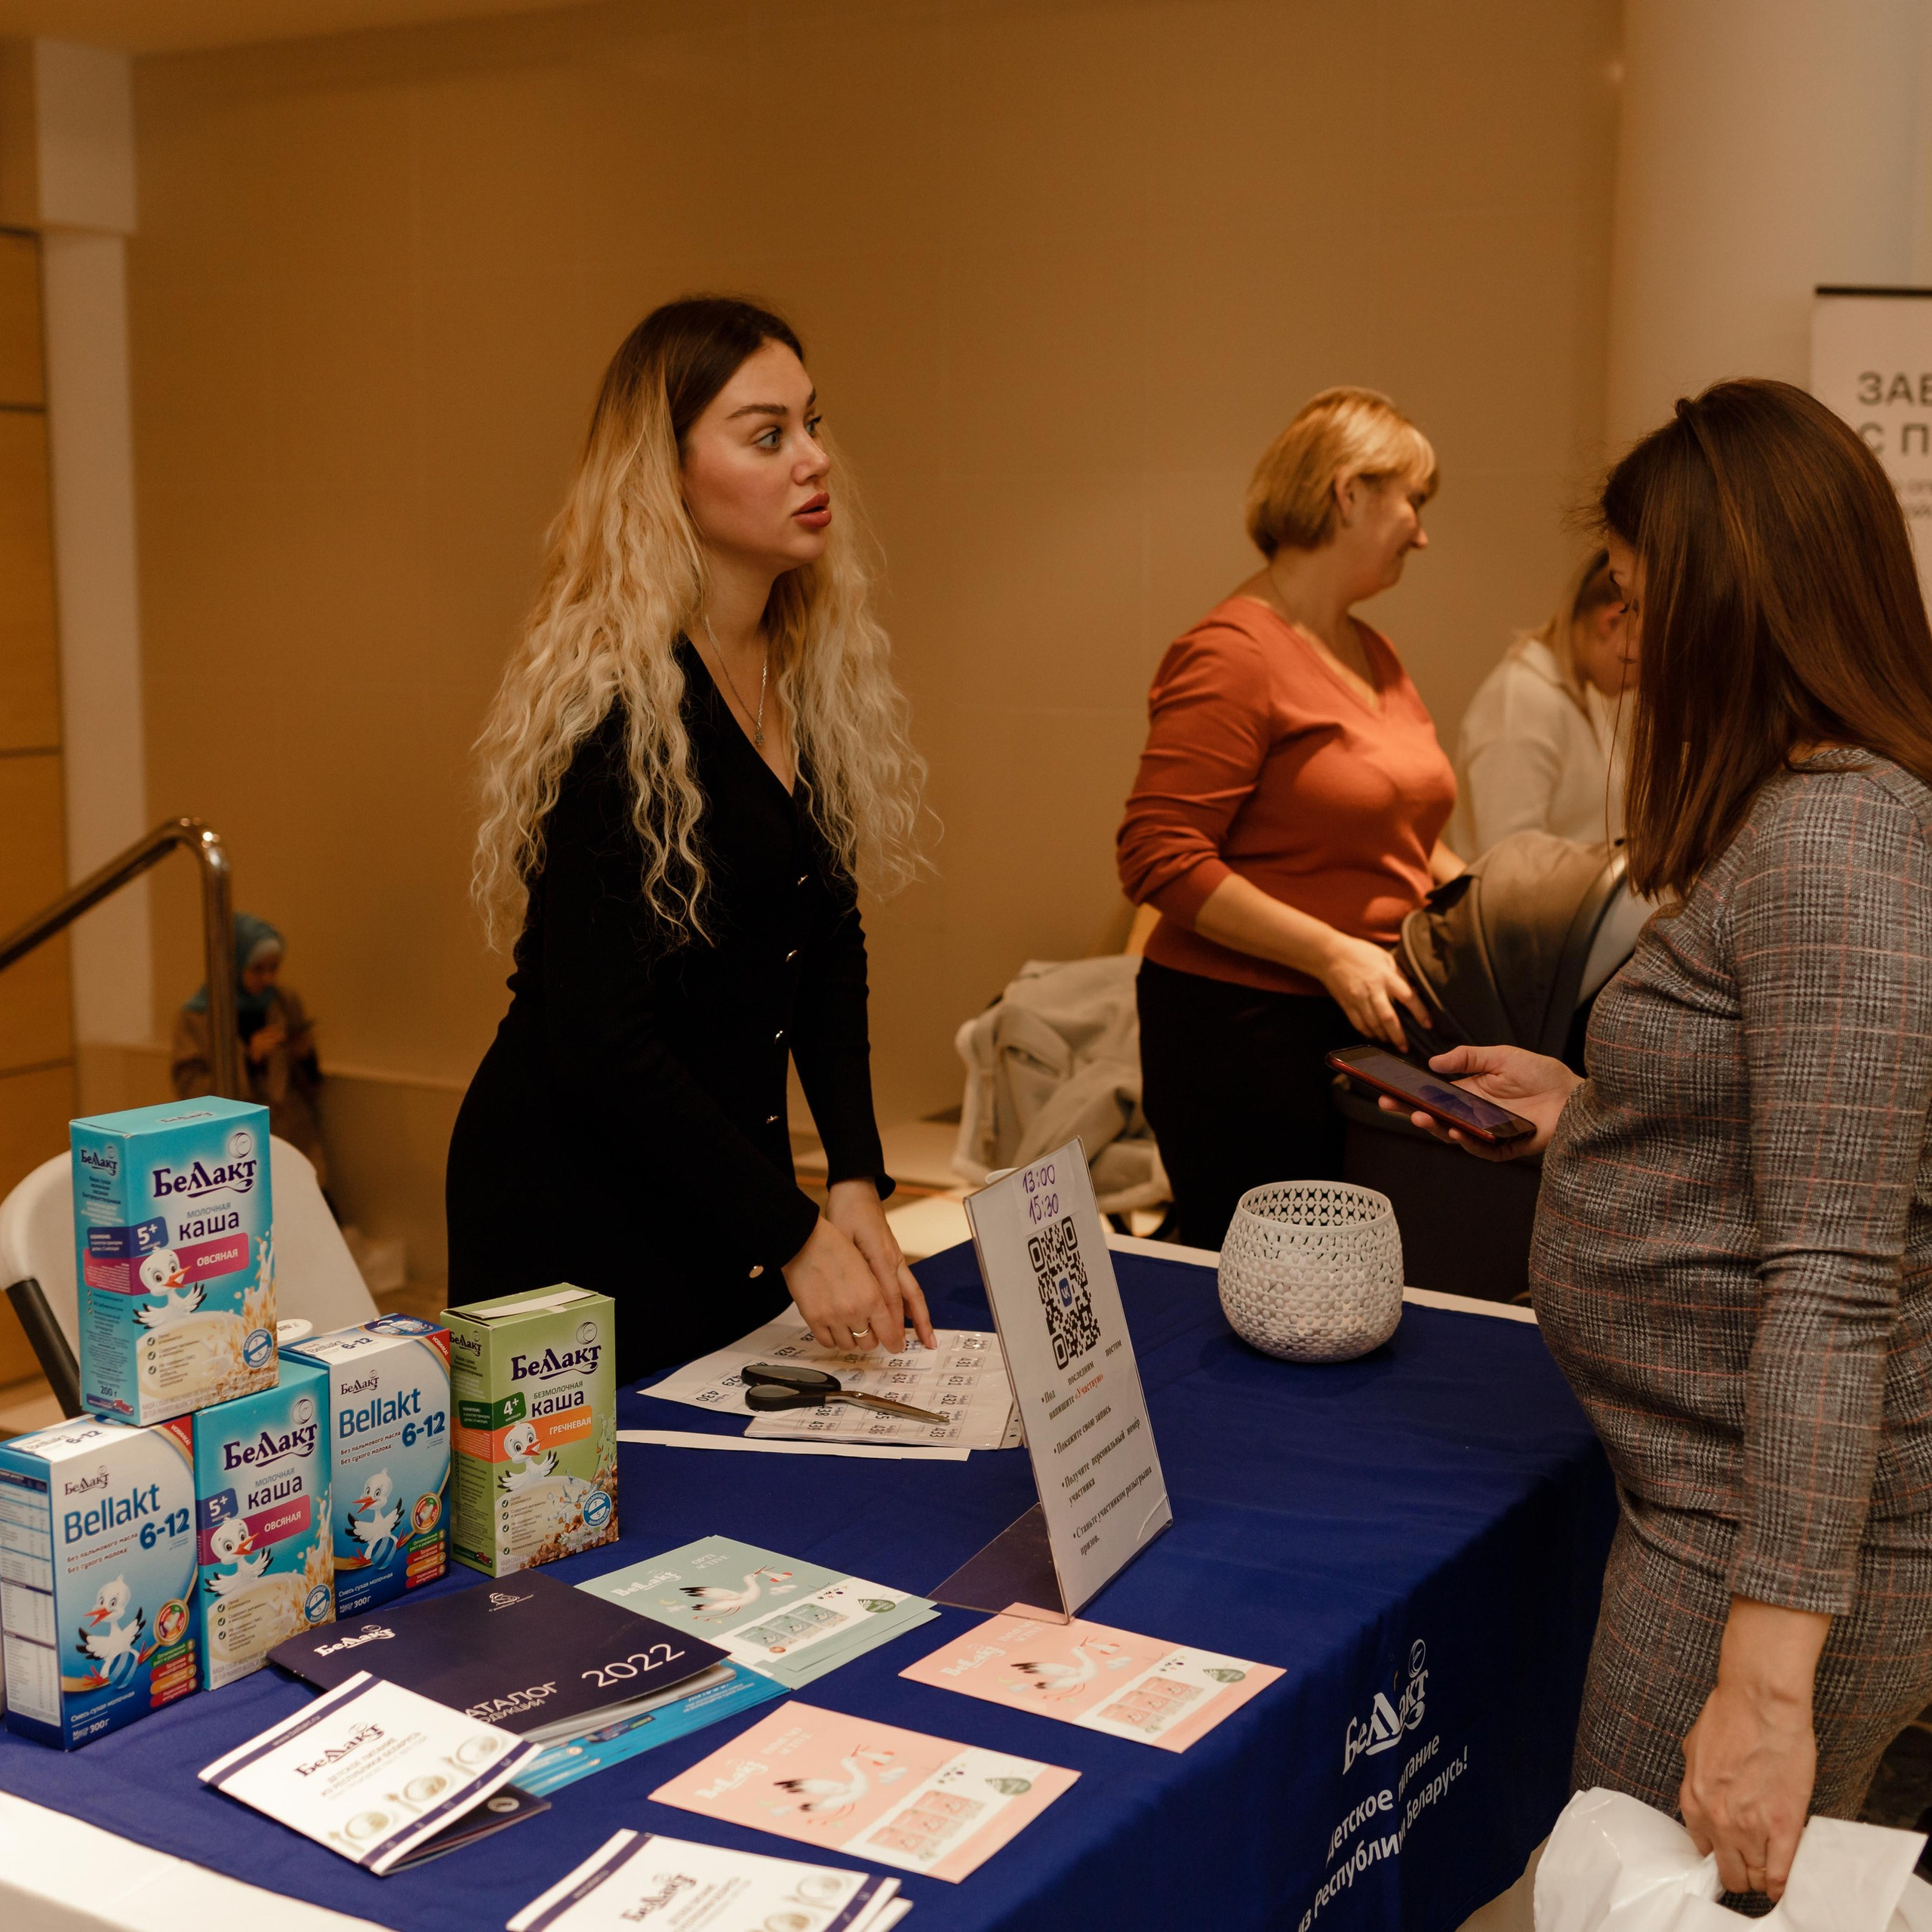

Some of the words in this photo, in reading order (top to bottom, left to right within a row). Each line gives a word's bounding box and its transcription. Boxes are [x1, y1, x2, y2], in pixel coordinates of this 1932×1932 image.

[1023, 1164, 1055, 1193] 13:00
[187, 1202, 231, 1219] МОЛОЧНАЯ
[1029, 1193, 1060, 1225] 15:30
[137, 1224, 158, 1245] 5+
[179, 1211, 239, 1241] каша
[196, 1248, 238, 1267] ОВСЯНАЯ
[341, 1337, 374, 1349] 6-12
[1068, 1361, 1094, 1386] последним
[1105, 1340, 1122, 1357] постом
[531, 1390, 584, 1417] каша
[534, 1380, 583, 1399] БЕЗМОЛОЧНАЯ
[340, 1388, 421, 1439] Bellakt
[503, 1398, 519, 1415] 4+
[1048, 1395, 1075, 1420] напишите
[401, 1411, 445, 1447] 6-12
[549, 1417, 592, 1435] ГРЕЧНЕВАЯ
[1057, 1429, 1082, 1454] Покажите
[1082, 1418, 1094, 1433] свою
[1095, 1405, 1112, 1423] запись
[1065, 1462, 1090, 1488] Получите
[1091, 1430, 1125, 1466] персональный
[1127, 1419, 1140, 1435] номер
[255, 1467, 295, 1487] МОЛОЧНАЯ
[209, 1495, 228, 1517] 5+
[248, 1475, 302, 1510] каша
[1068, 1478, 1096, 1508] участника
[1076, 1515, 1097, 1539] Станьте
[1097, 1490, 1126, 1523] участником
[1125, 1466, 1152, 1497] розыгрыша
[64, 1484, 160, 1544] Bellakt
[140, 1508, 189, 1550] 6-12
[264, 1511, 301, 1533] ОВСЯНАЯ
[354, 1595, 371, 1608] 300г
[581, 1643, 685, 1687] 2022
[466, 1681, 557, 1717] АТАЛОГ
[1407, 1745, 1468, 1829] Беларусь!
